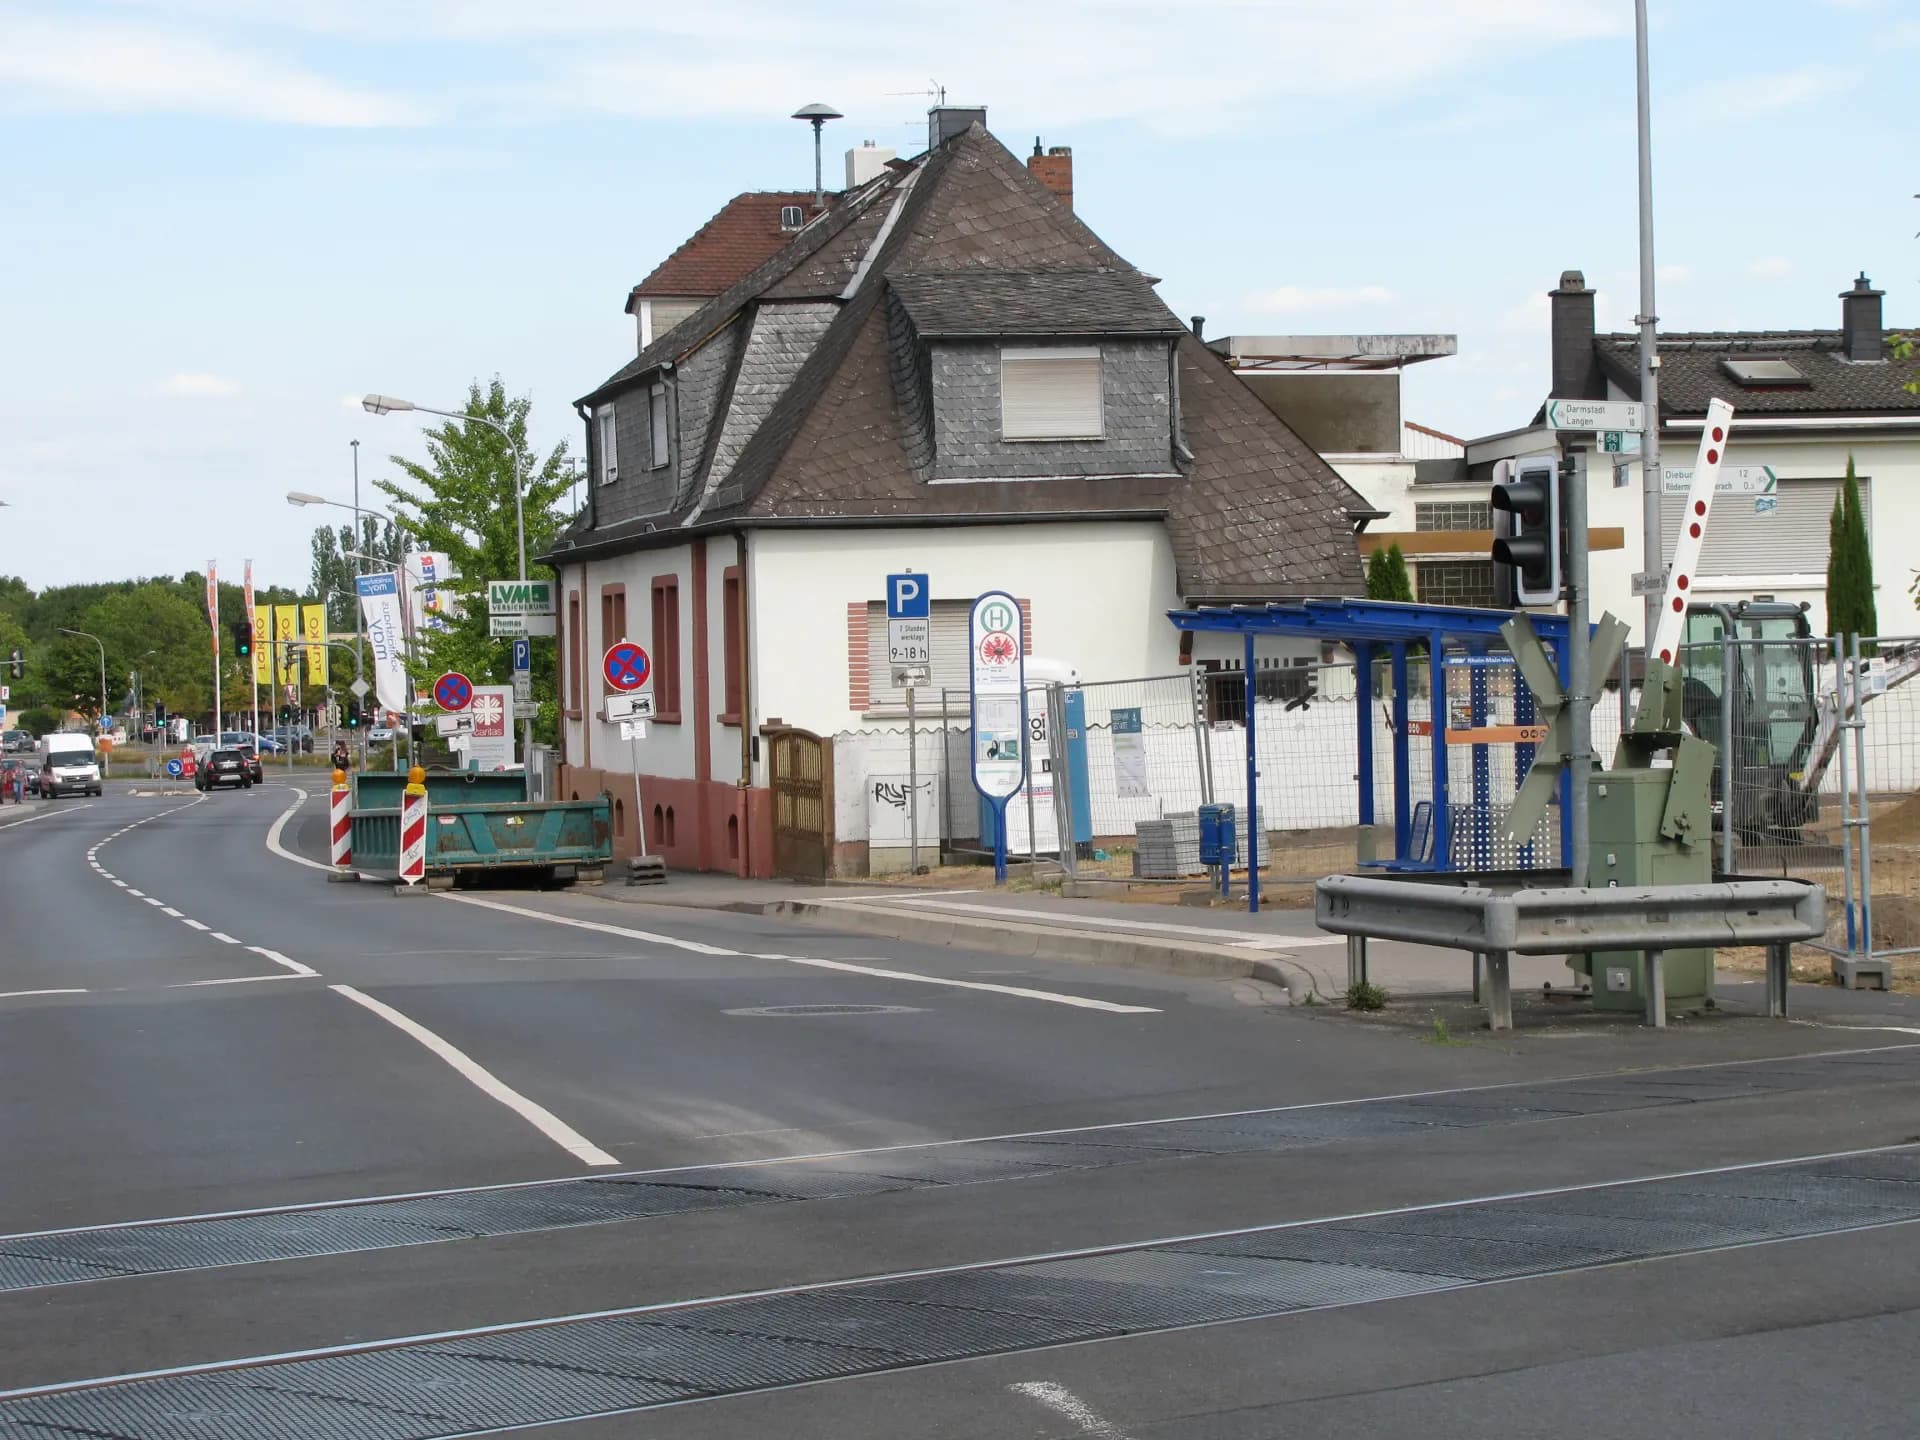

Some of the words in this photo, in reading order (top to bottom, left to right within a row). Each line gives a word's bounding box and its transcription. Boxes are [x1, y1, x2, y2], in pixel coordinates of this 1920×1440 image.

[1566, 404, 1605, 414] Darmstadt
[1566, 417, 1594, 426] Langen
[1665, 470, 1694, 479] Diebur
[1739, 469, 1748, 477] 12
[491, 584, 530, 604] LVM
[896, 579, 919, 613] P
[989, 608, 1004, 628] H
[517, 643, 526, 667] P
[891, 647, 917, 660] 9-18
[920, 647, 927, 659] h
[474, 728, 503, 737] caritas
